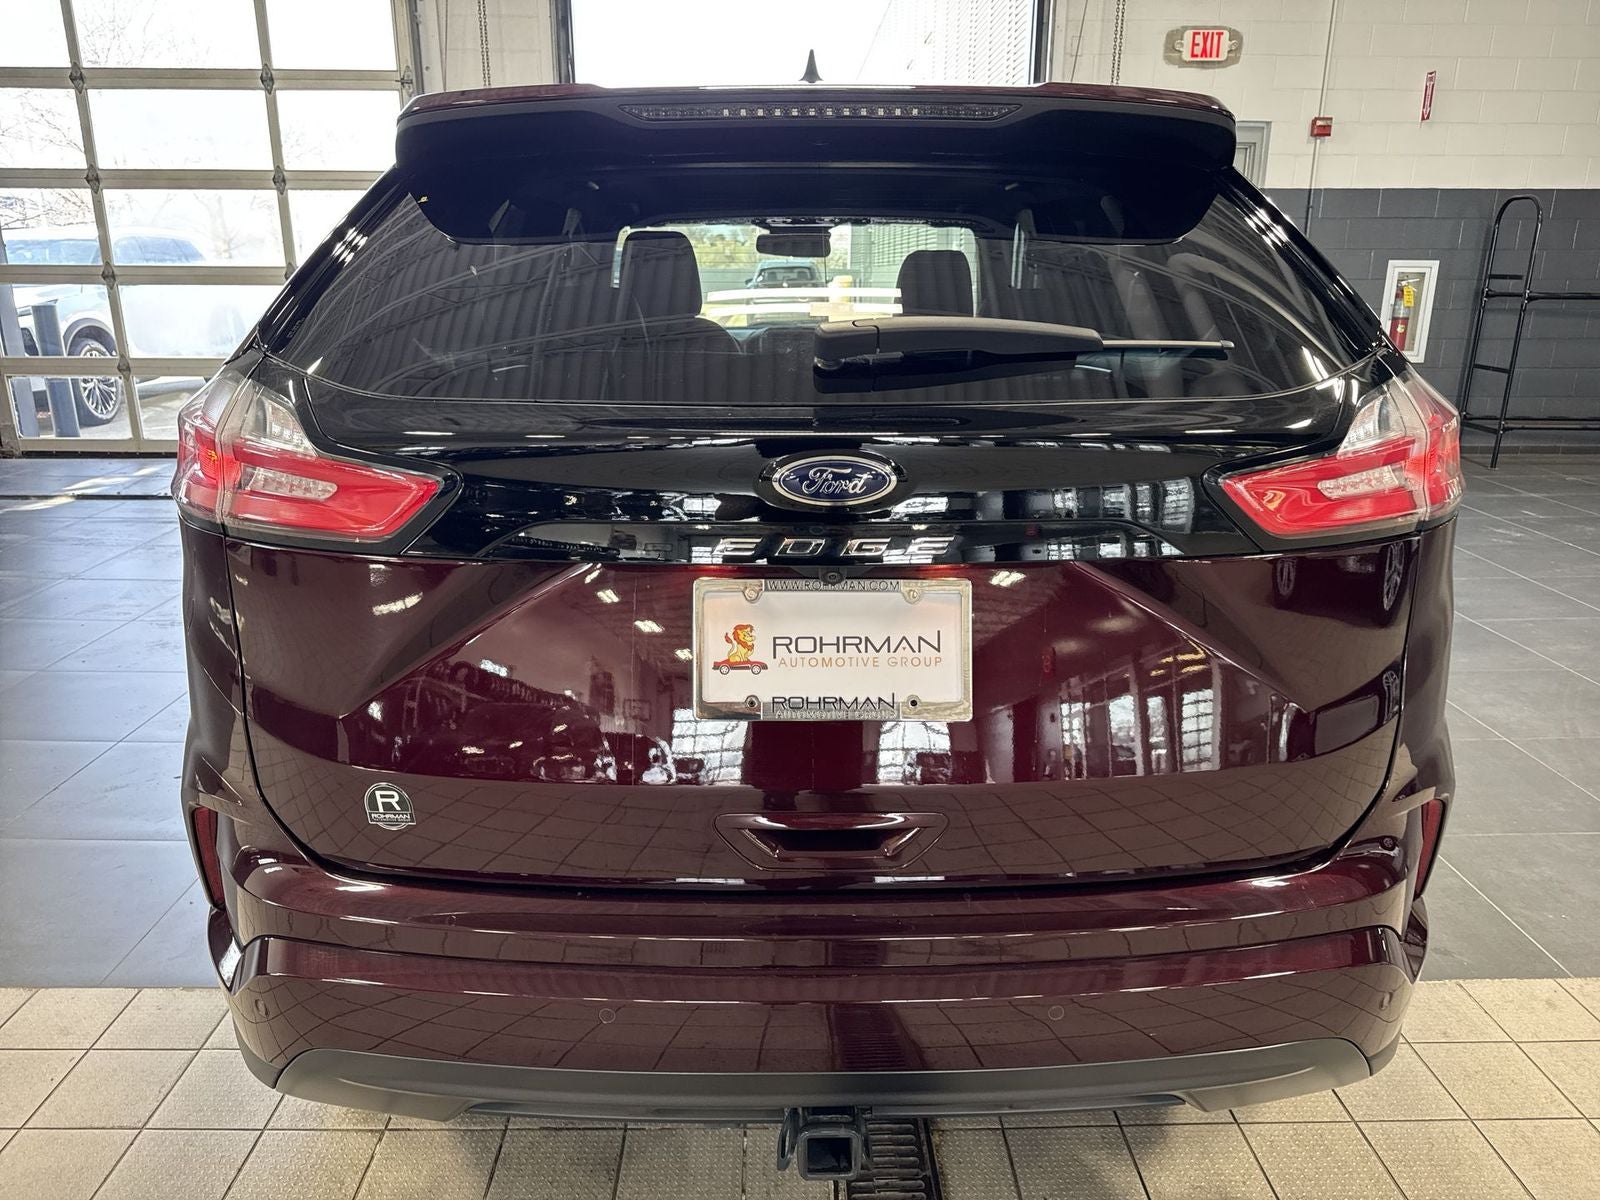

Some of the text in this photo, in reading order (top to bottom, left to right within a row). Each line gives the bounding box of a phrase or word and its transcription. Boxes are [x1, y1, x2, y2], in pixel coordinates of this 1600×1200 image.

[1190, 31, 1224, 59] EXIT
[802, 466, 868, 495] Ford
[712, 536, 956, 556] EDGE
[772, 630, 941, 659] ROHRMAN
[778, 656, 943, 668] AUTOMOTIVE GROUP
[771, 692, 895, 713] ROHRMAN
[374, 790, 402, 813] R
